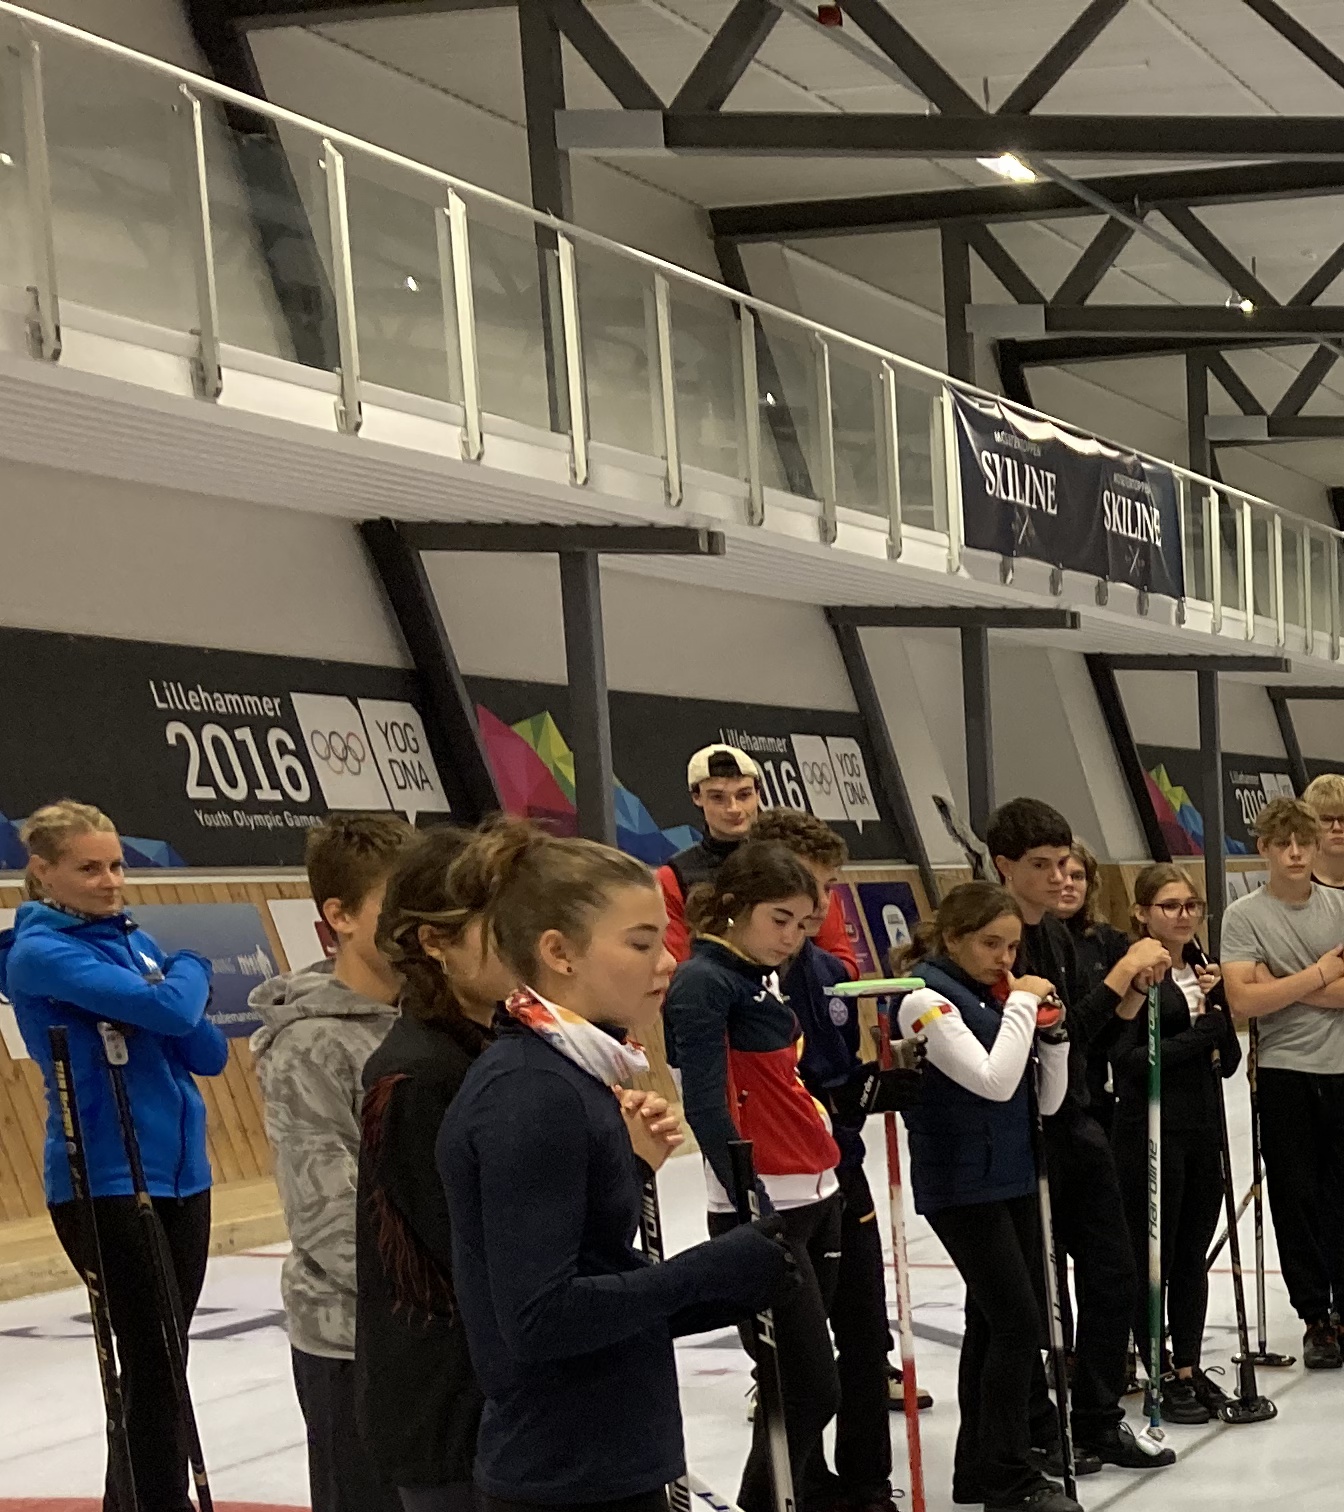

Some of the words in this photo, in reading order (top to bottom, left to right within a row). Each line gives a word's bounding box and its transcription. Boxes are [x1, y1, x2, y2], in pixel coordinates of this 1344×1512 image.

[981, 449, 1058, 516] SKILINE
[1103, 489, 1162, 547] SKILINE
[150, 679, 282, 717] Lillehammer
[375, 719, 420, 754] YOG
[165, 720, 311, 802] 2016
[388, 757, 434, 792] DNA
[836, 753, 861, 779] YOG
[755, 758, 806, 812] 016
[844, 781, 871, 806] DNA
[194, 809, 231, 828] Youth
[234, 809, 283, 832] Olympic
[285, 811, 323, 829] Games
[1149, 1138, 1158, 1241] Hardline
